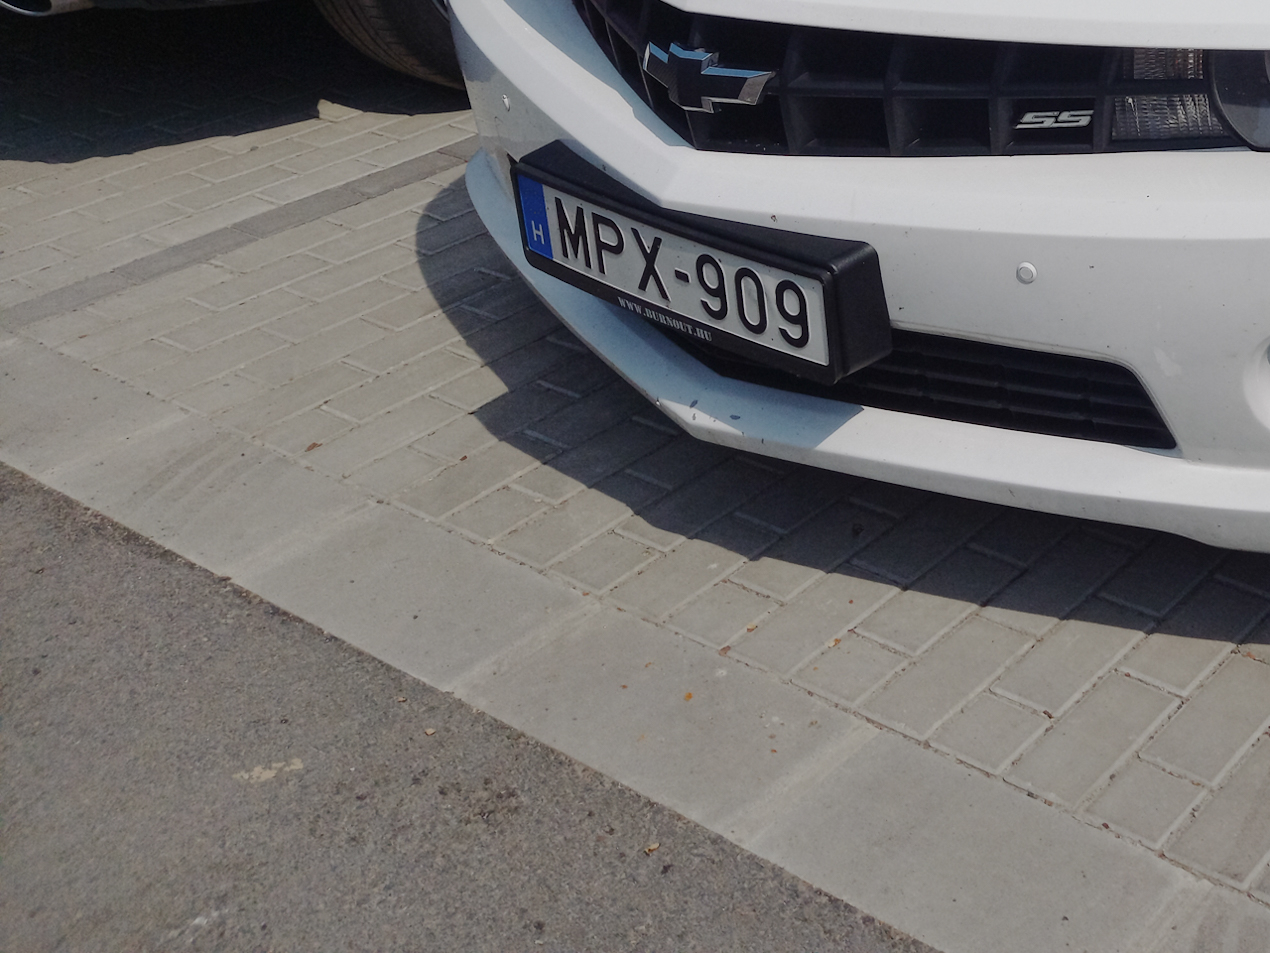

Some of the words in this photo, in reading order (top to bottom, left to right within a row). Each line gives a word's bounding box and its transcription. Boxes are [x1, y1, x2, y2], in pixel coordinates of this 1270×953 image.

[1014, 110, 1095, 129] SS
[532, 220, 546, 245] H
[554, 196, 811, 349] MPX-909
[617, 295, 713, 342] WWW.BURNOUT.HU
